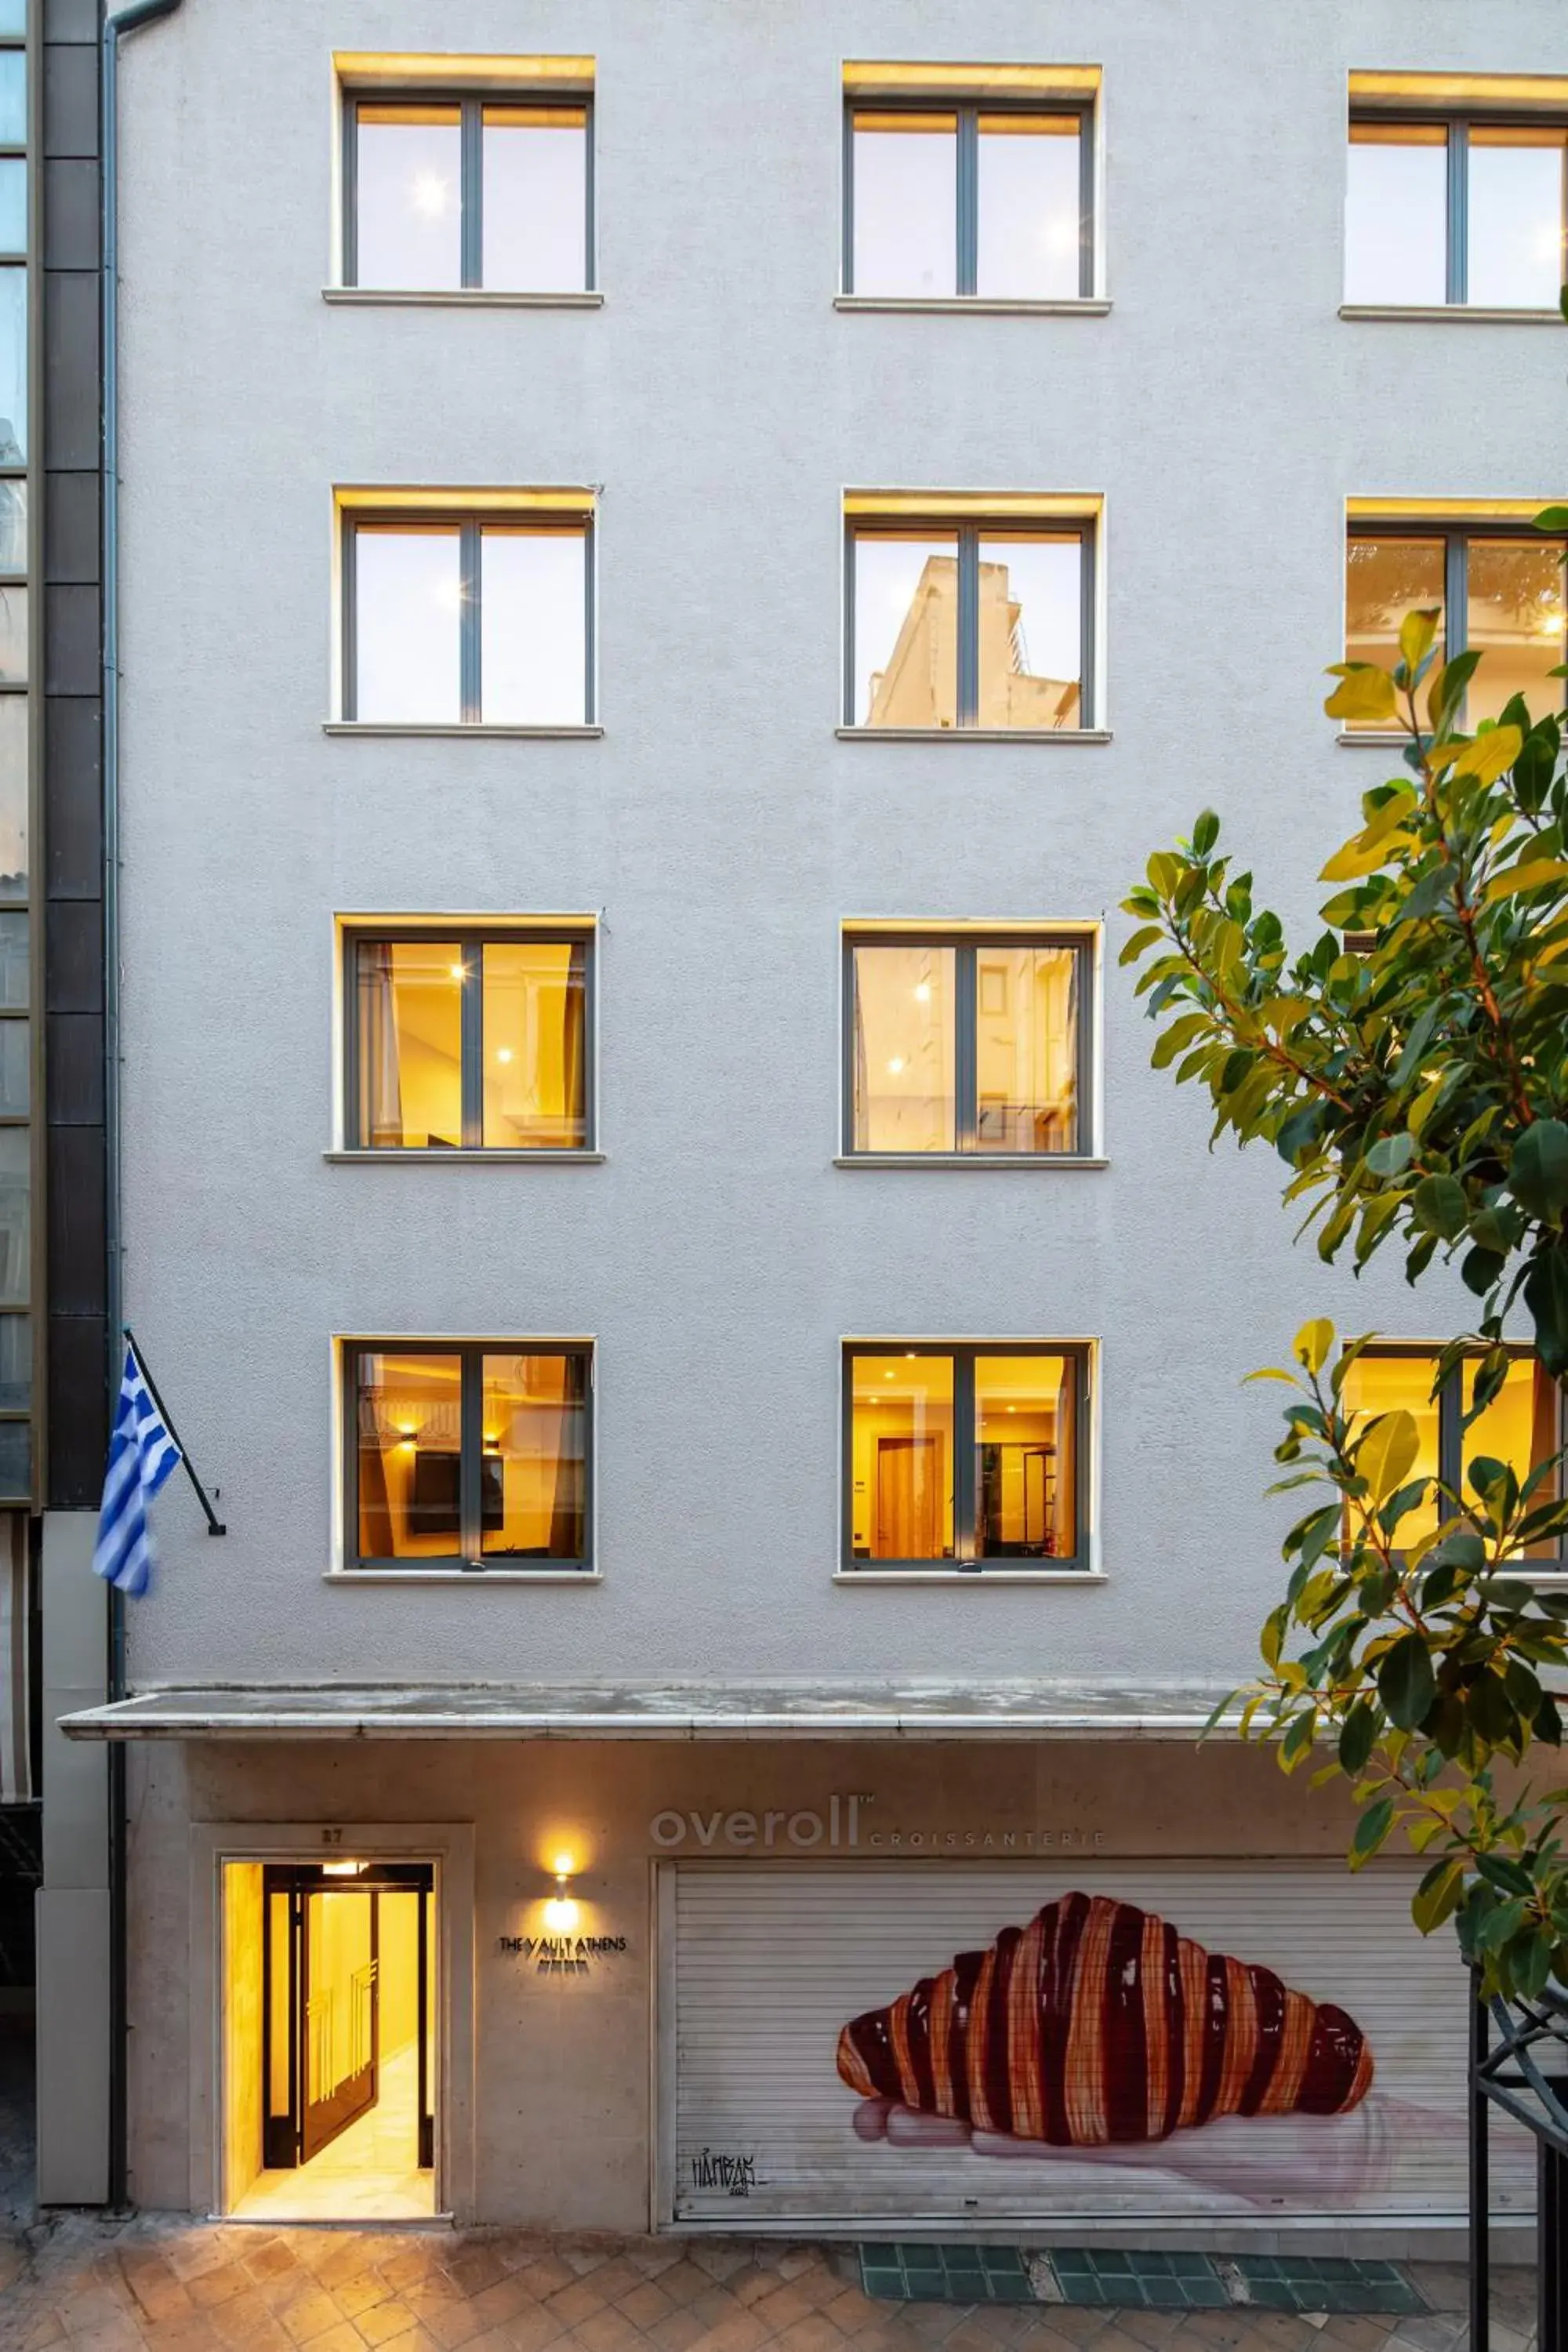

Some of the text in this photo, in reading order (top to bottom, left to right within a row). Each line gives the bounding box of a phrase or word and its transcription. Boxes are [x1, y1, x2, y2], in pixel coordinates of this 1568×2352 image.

[649, 1794, 858, 1847] overoll
[869, 1831, 1105, 1846] CROISSANTERIE
[499, 1936, 626, 1952] THE VAULT ATHENS
